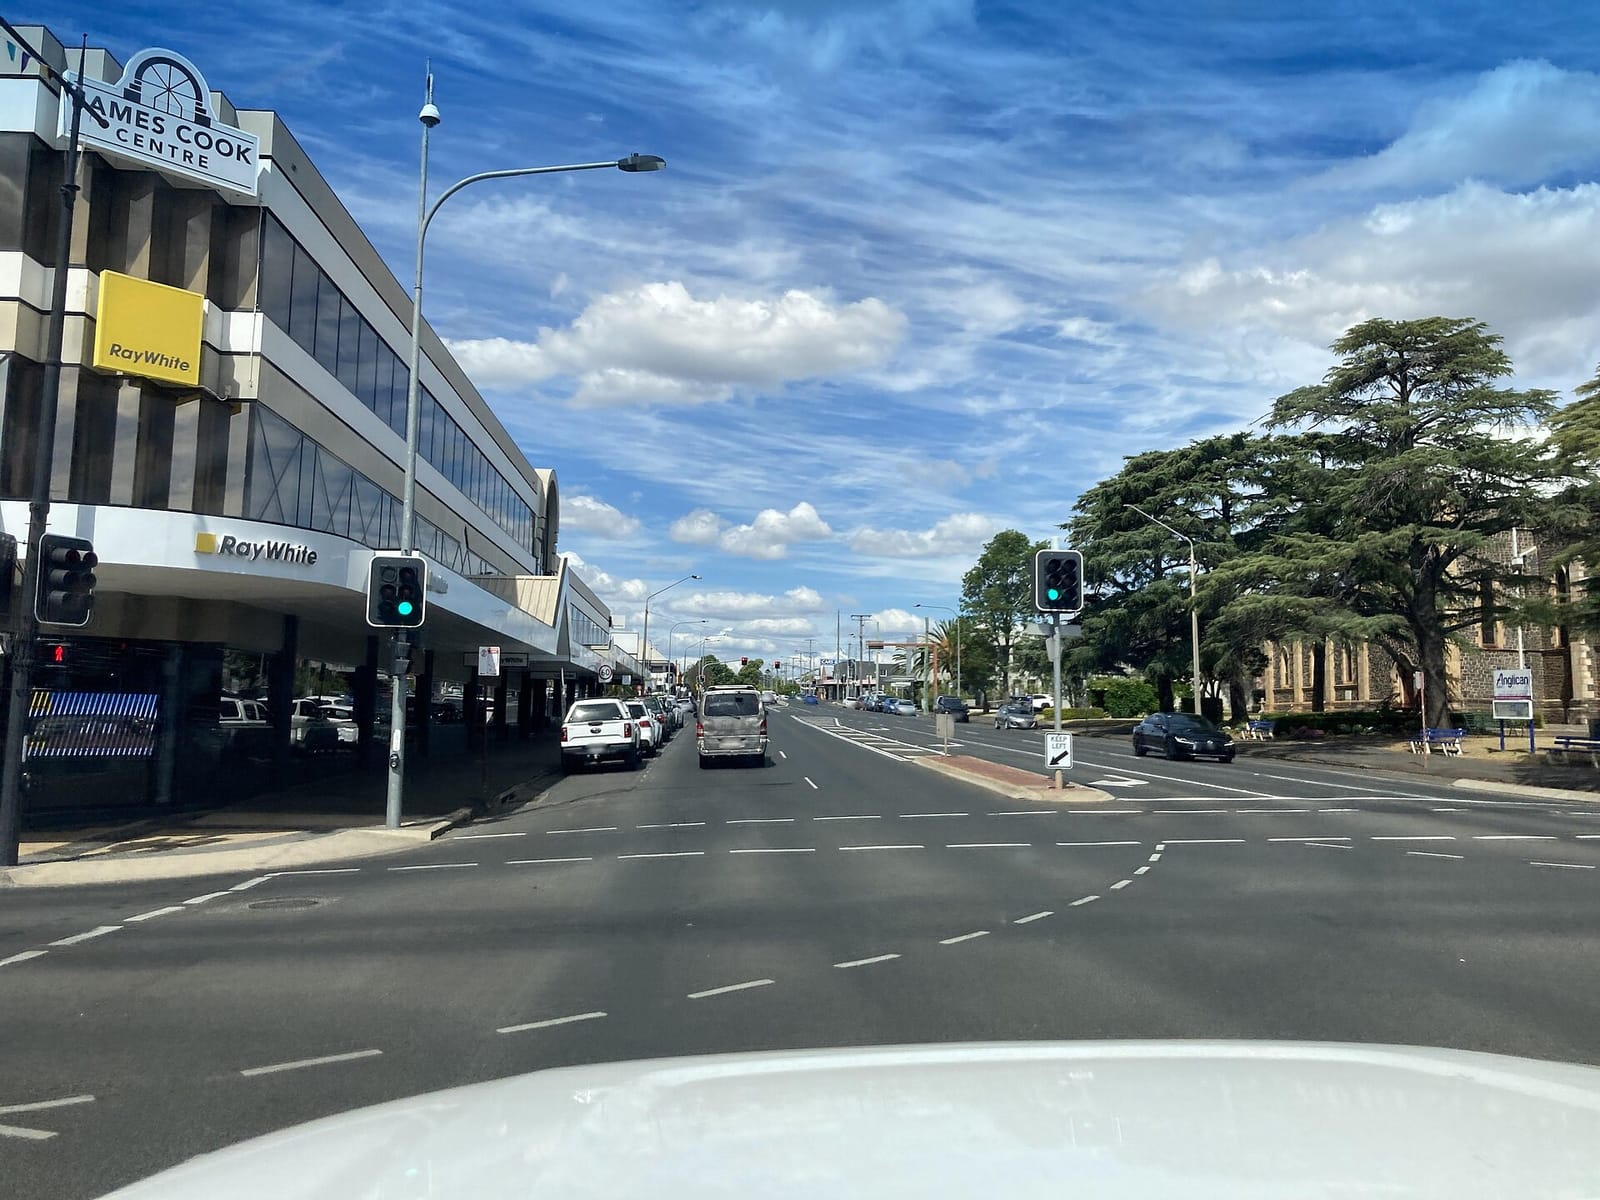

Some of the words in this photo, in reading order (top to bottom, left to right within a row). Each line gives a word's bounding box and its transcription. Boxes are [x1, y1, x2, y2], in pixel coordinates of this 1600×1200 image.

[88, 95, 165, 135] AMES
[176, 124, 252, 165] COOK
[116, 128, 208, 169] CENTRE
[600, 668, 611, 677] 60
[1496, 672, 1529, 689] Anglican
